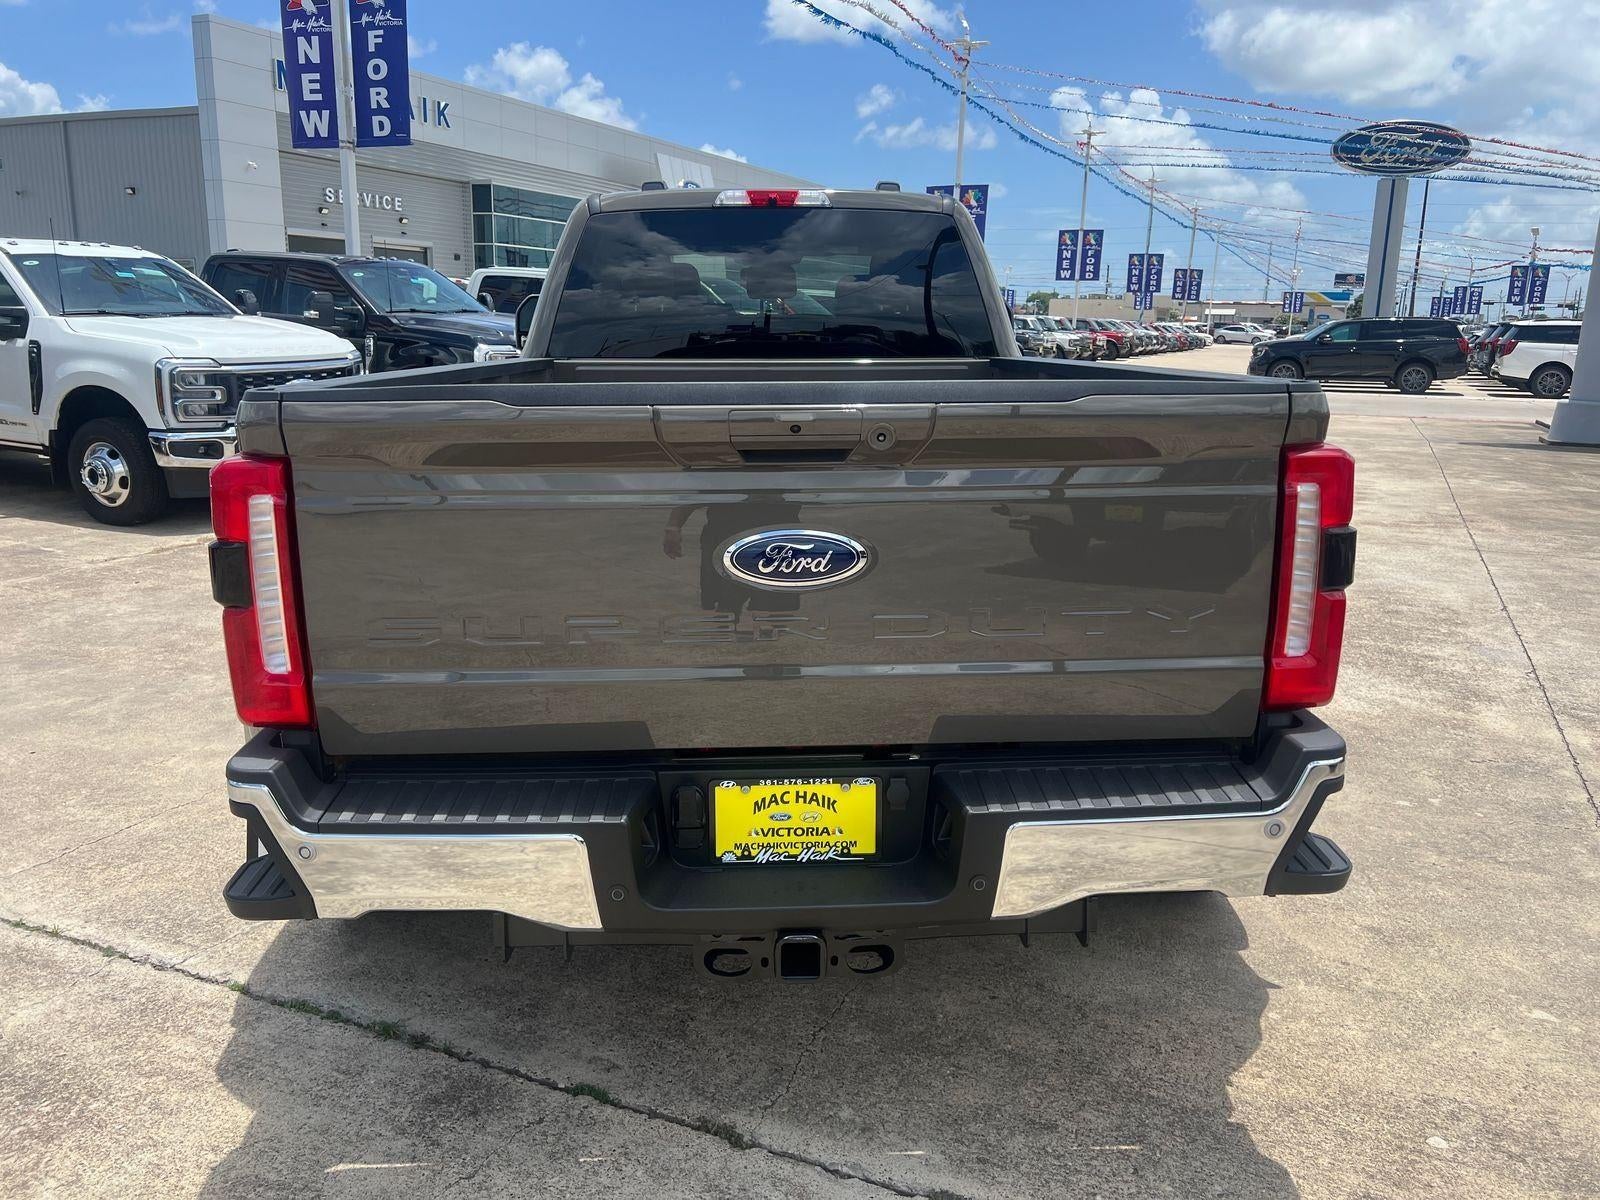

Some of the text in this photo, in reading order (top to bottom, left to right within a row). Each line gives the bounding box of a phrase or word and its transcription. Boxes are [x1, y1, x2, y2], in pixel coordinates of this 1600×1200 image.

[297, 35, 330, 138] NEW
[367, 29, 392, 137] FORD
[1361, 131, 1439, 163] Ford
[325, 187, 403, 211] SEVICE
[1060, 249, 1072, 279] NEW
[1085, 249, 1096, 279] FORD
[1130, 268, 1140, 291] NEW
[1150, 268, 1158, 291] FORD
[1174, 280, 1184, 299] NEW
[1512, 280, 1522, 303] NEW
[1532, 280, 1542, 303] FORD
[757, 542, 834, 574] Ford
[367, 607, 1216, 647] SUPER DUTY
[759, 778, 833, 786] 361-576-1221
[753, 790, 838, 814] MAC HAIK
[760, 826, 831, 837] VICTORIA
[734, 840, 858, 851] MACHAIKVICTORIA.COM
[752, 847, 796, 863] Mac
